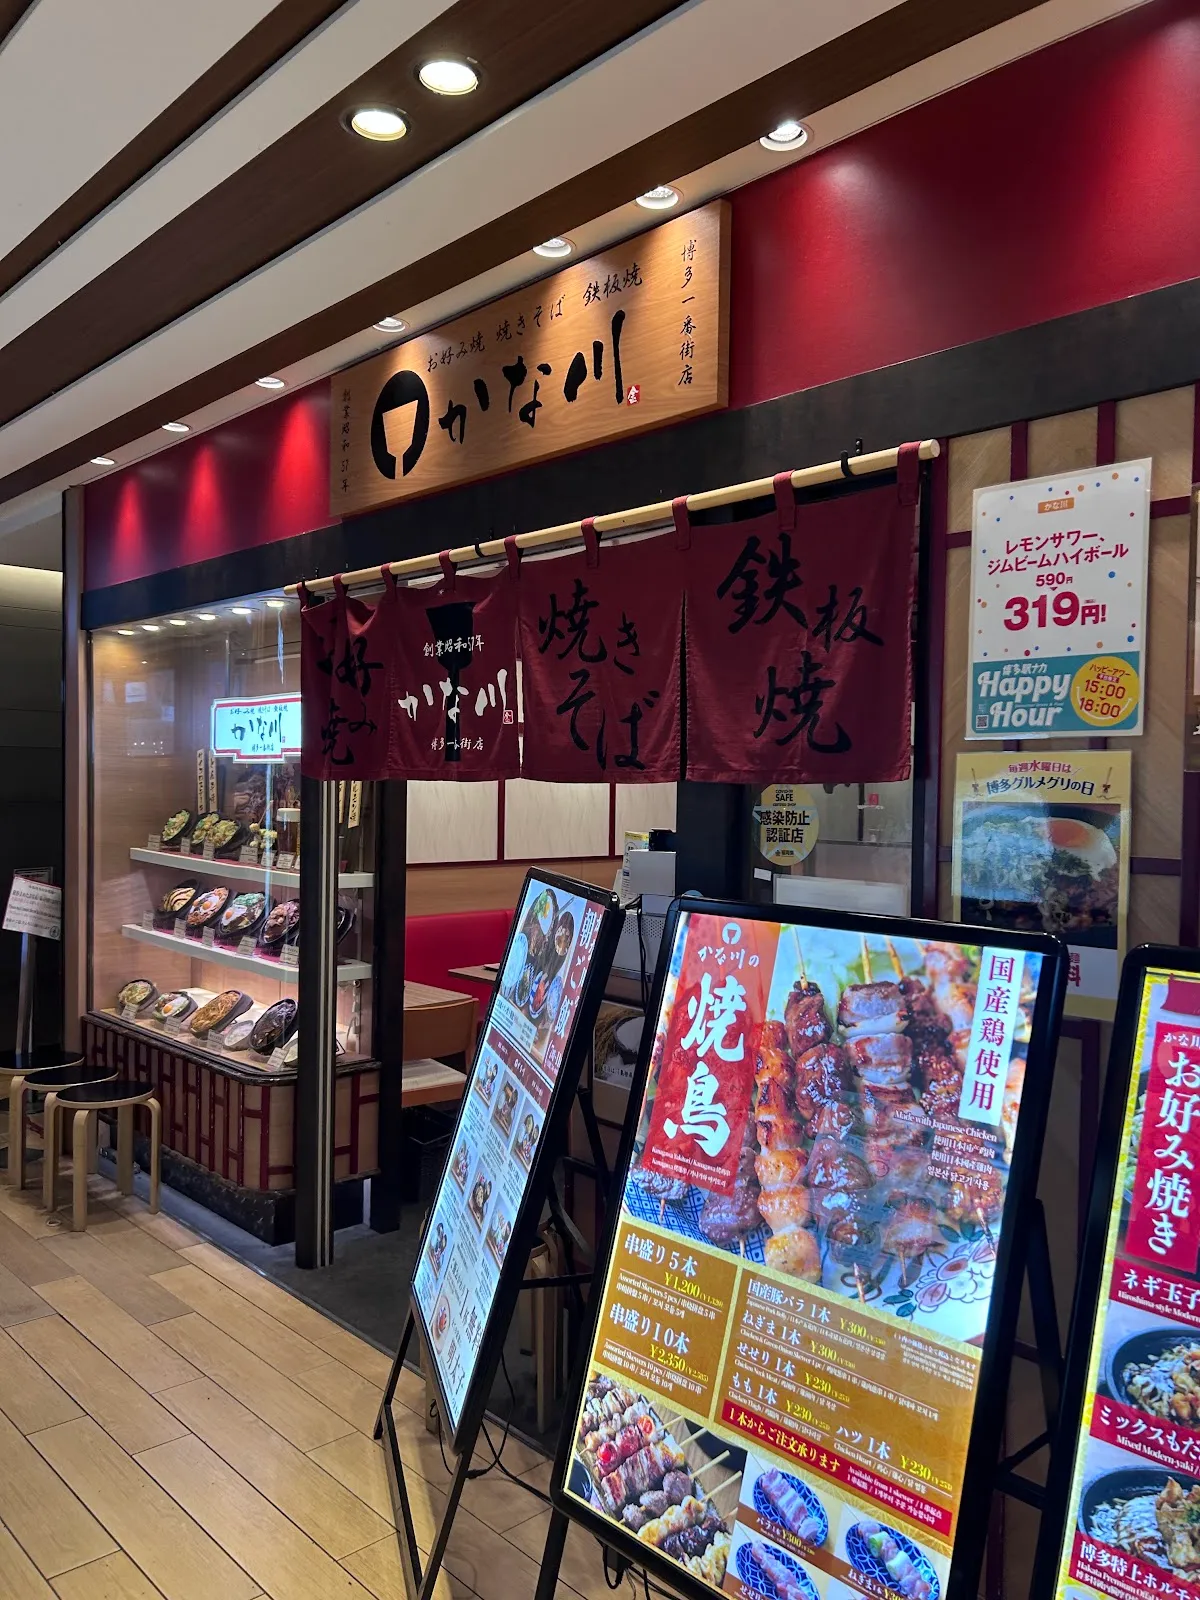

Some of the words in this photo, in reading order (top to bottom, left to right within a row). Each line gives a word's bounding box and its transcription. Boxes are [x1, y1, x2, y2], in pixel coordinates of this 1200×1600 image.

[427, 331, 486, 373] お好み焼
[496, 294, 566, 343] 焼きそば
[582, 262, 643, 306] 鉄板焼
[677, 239, 698, 387] 博多一番街店
[438, 310, 627, 445] かな川
[987, 544, 1129, 576] ジムビームハイボール
[1036, 572, 1073, 587] 590円
[423, 635, 485, 657] 創業昭和57年
[977, 670, 1071, 703] Happy
[1089, 664, 1131, 677] ハッピーアワー
[398, 668, 508, 723] かな川
[1085, 679, 1126, 699] 15:00
[990, 701, 1063, 728] Hour
[1080, 697, 1121, 718] 18:00
[231, 712, 282, 743] かな川
[1008, 760, 1072, 773] 毎週水曜日は
[986, 776, 1095, 796] 博多グルメグリの日
[760, 810, 810, 825] 感染防止
[766, 828, 803, 843] 認証店
[698, 945, 759, 969] かな川の
[968, 955, 1015, 1111] 国産鶏使用
[663, 972, 747, 1157] 焼鳥
[894, 1110, 914, 1121] Made
[914, 1114, 931, 1125] with
[931, 1119, 965, 1135] Japanese
[965, 1126, 997, 1141] Chicken
[1144, 1051, 1200, 1256] お好み焼き
[662, 1271, 700, 1298] ¥1,200
[1121, 1268, 1200, 1312] ネギ玉子
[747, 1278, 805, 1314] 国産豚バラ
[809, 1302, 831, 1325] 1本
[838, 1317, 867, 1338] ¥300
[742, 1308, 776, 1336] ねぎま
[780, 1324, 801, 1347] 1本
[809, 1339, 837, 1361] ¥300
[648, 1343, 686, 1373] ¥2,350
[736, 1339, 769, 1366] せせり
[775, 1355, 796, 1379] 1本
[803, 1371, 831, 1394] ¥230
[731, 1370, 753, 1394] もも
[757, 1382, 778, 1407] 1本
[784, 1399, 812, 1423] ¥230
[728, 1405, 840, 1475] 1本からご注文承ります
[1099, 1405, 1200, 1461] ミックスもだ
[835, 1422, 862, 1446] ハツ
[867, 1435, 891, 1462] 1本
[899, 1454, 932, 1481] ¥230
[1116, 1433, 1141, 1451] Mixed
[1142, 1443, 1193, 1474] Modern-yaki
[848, 1569, 872, 1590] ねぎま
[1080, 1541, 1200, 1600] 博多特上ホルモ
[1103, 1572, 1136, 1592] Premium
